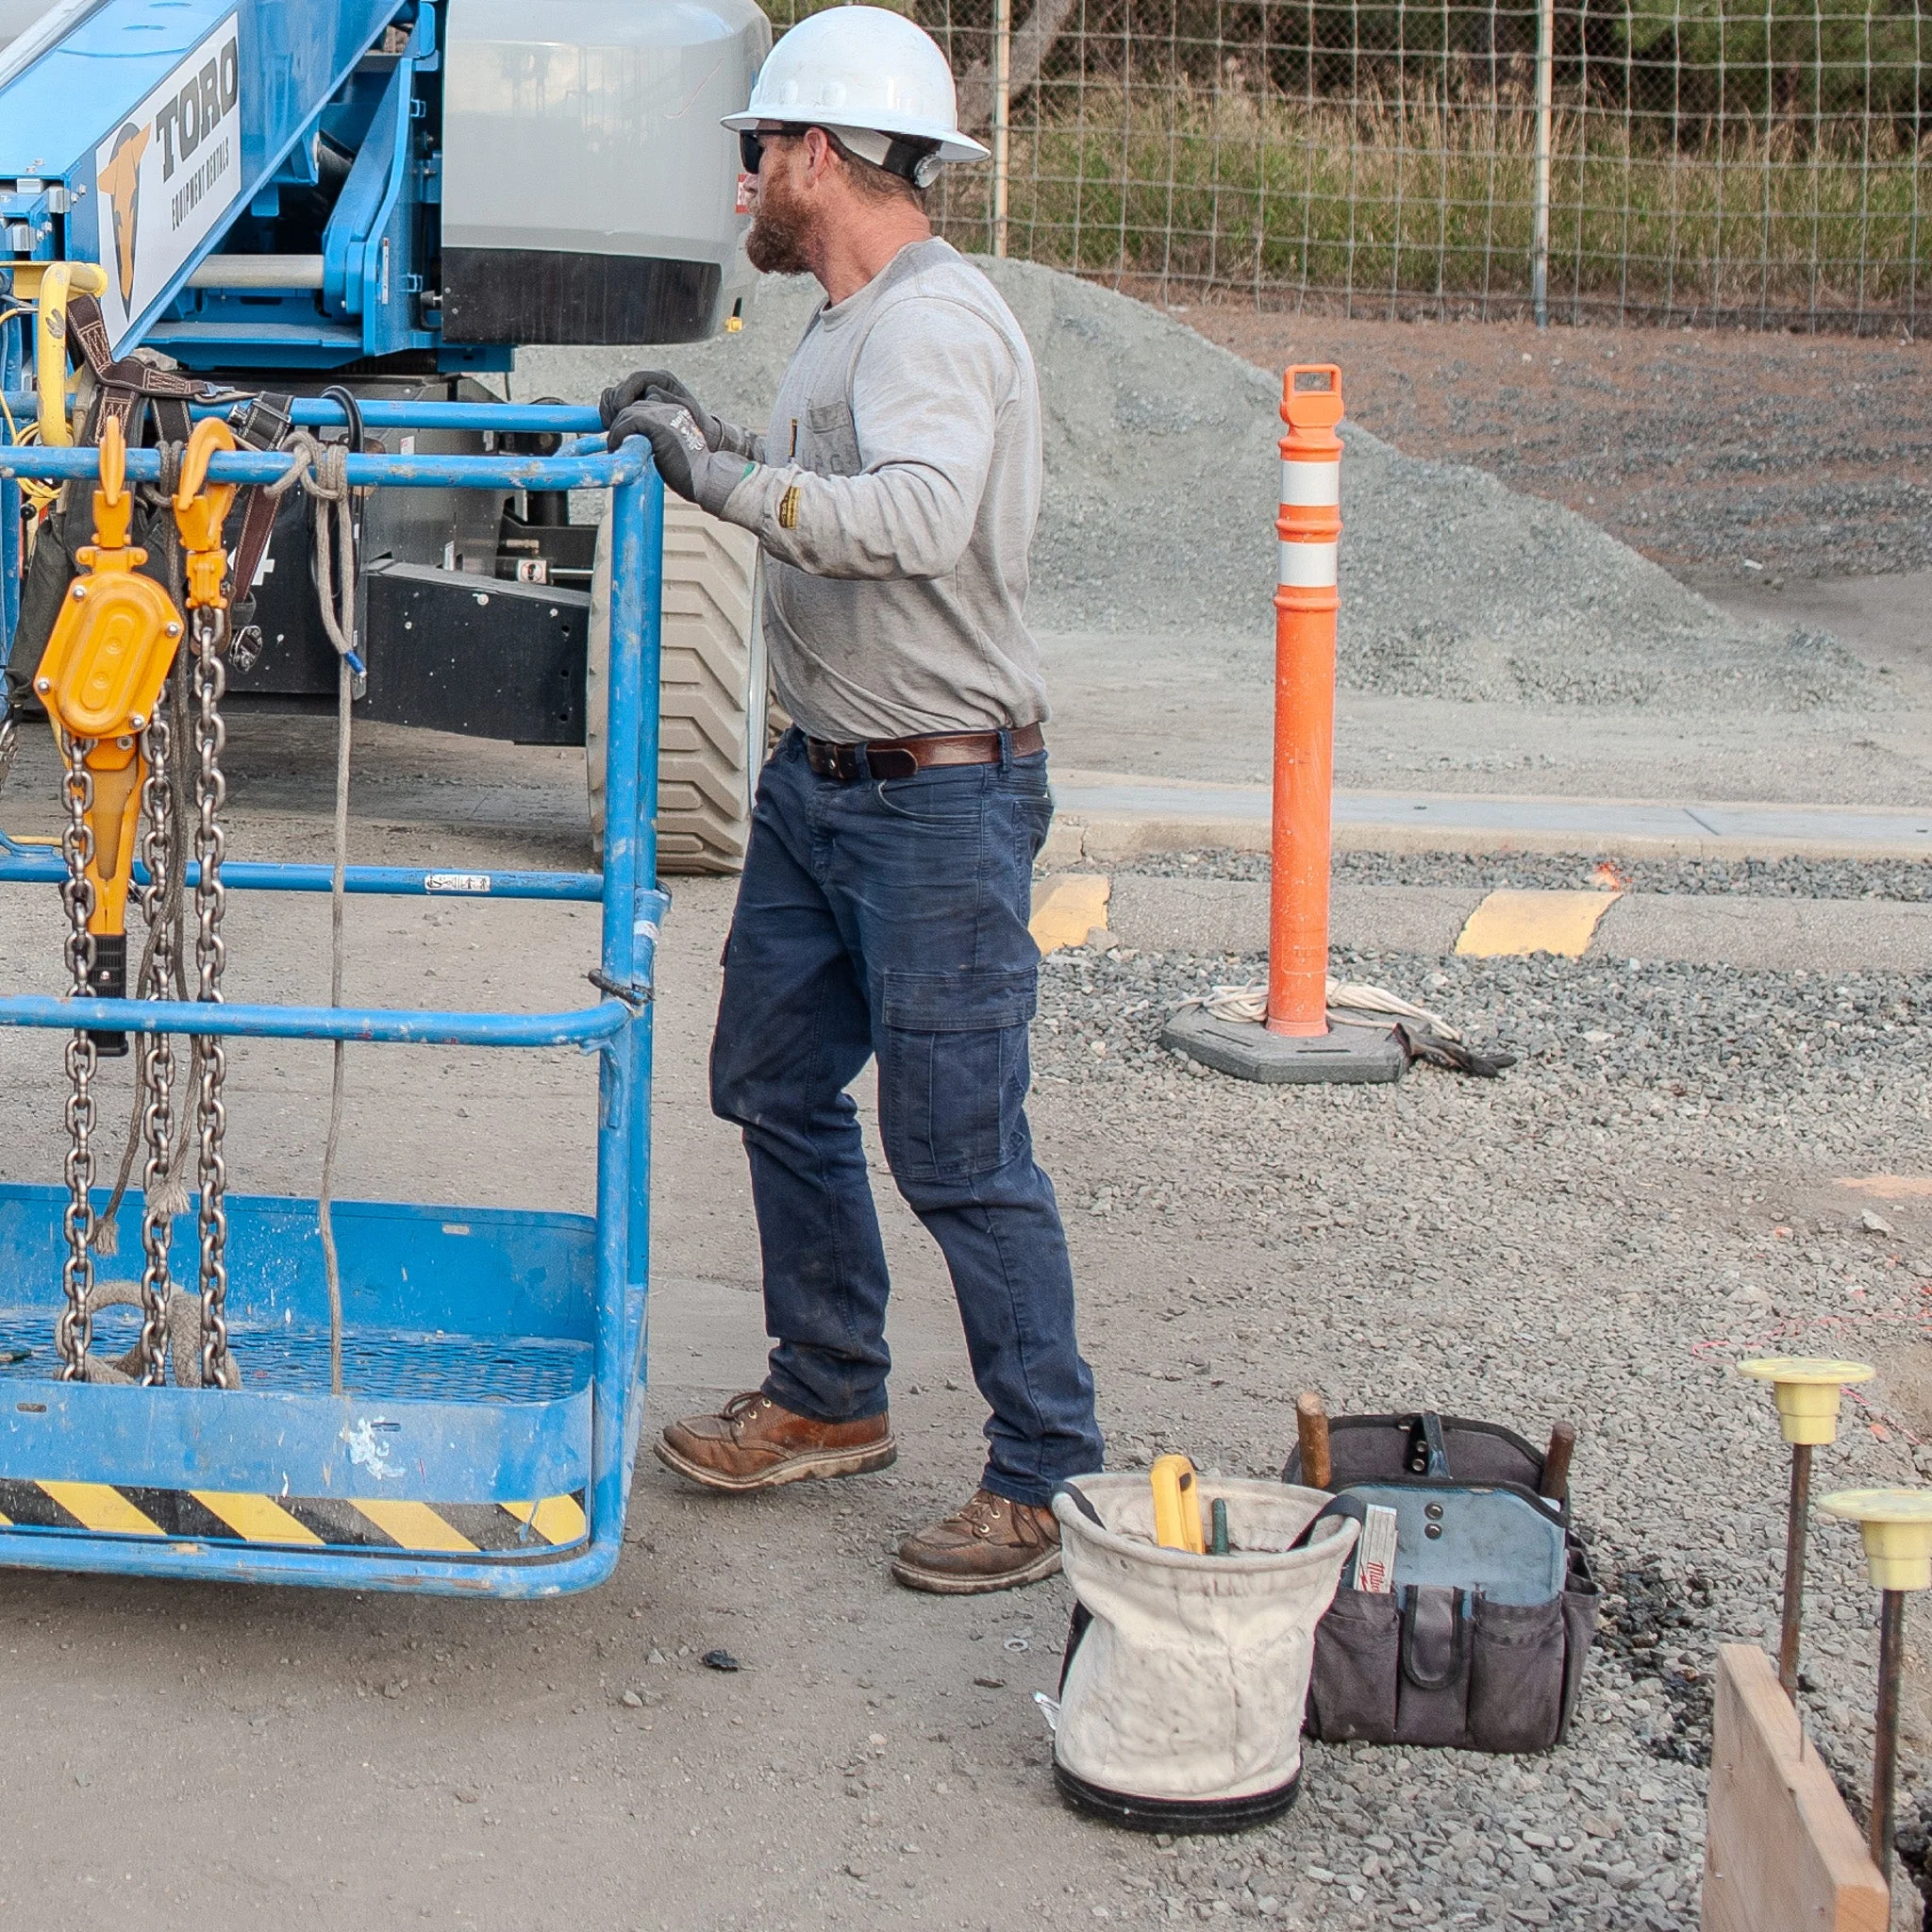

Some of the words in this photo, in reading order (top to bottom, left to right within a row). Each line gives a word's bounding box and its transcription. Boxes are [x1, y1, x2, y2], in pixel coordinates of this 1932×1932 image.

[156, 36, 237, 183] TORO
[172, 163, 206, 232] EQUIPMENT
[206, 136, 229, 192] RENTALS
